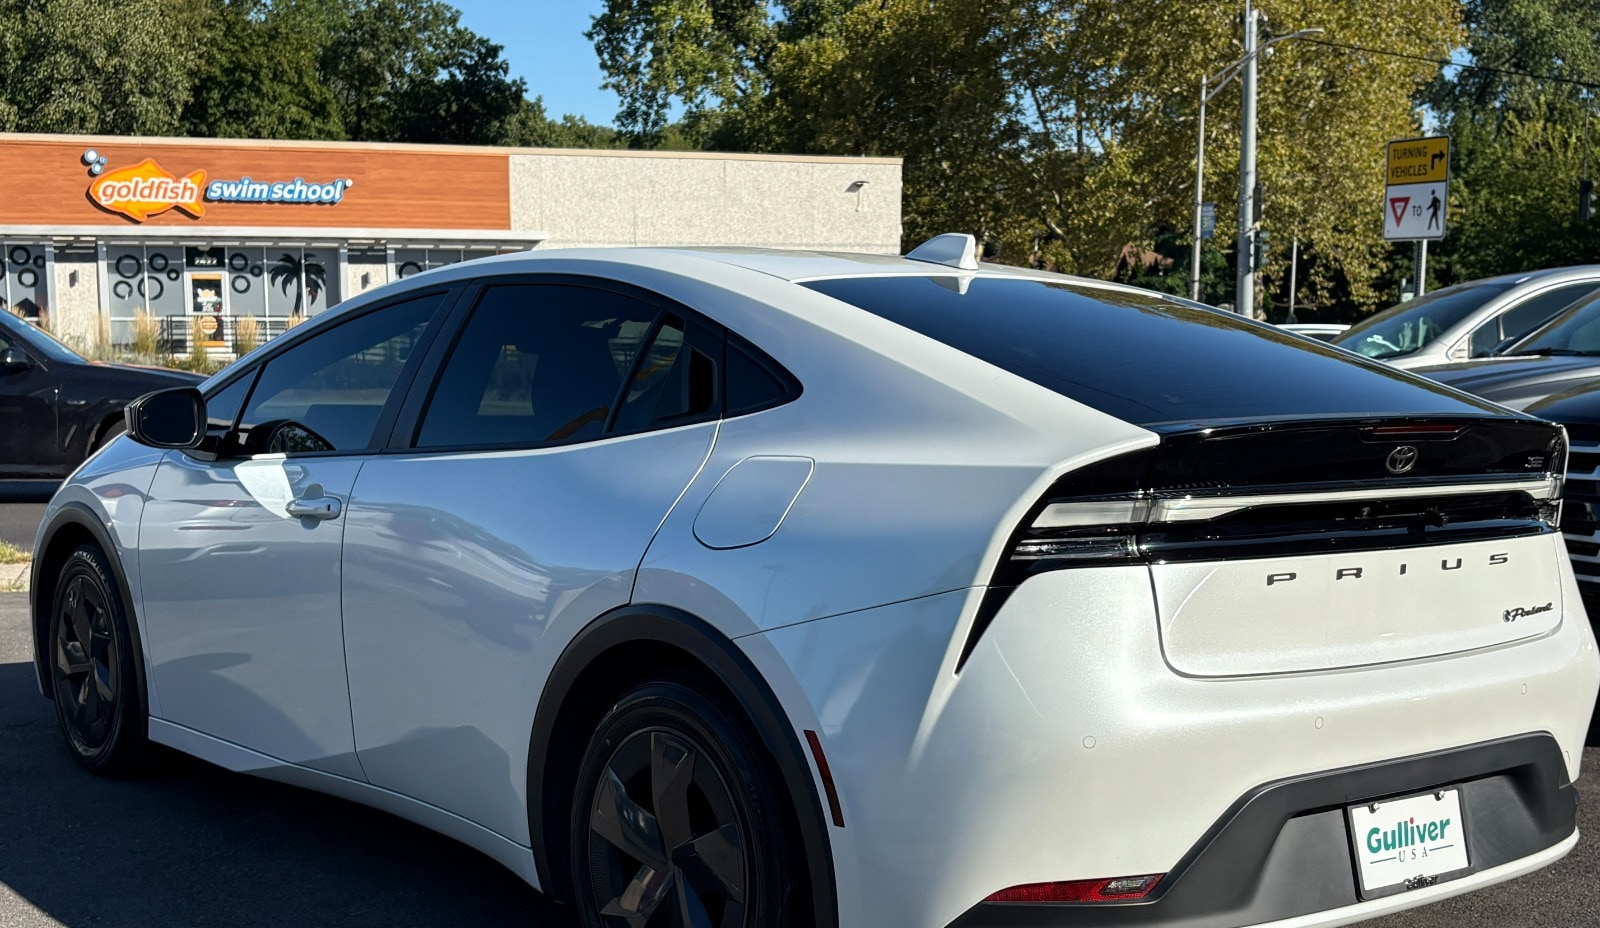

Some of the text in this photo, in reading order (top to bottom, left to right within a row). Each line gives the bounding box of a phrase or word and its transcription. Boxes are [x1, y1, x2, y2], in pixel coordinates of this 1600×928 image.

[1393, 146, 1428, 161] TURNING
[1391, 164, 1428, 179] VEHICLES
[100, 176, 343, 204] goldfish swim school
[1412, 205, 1422, 217] TO
[1266, 552, 1509, 586] PRIUS
[1366, 816, 1451, 854] Gulliver
[1398, 846, 1428, 862] USA
